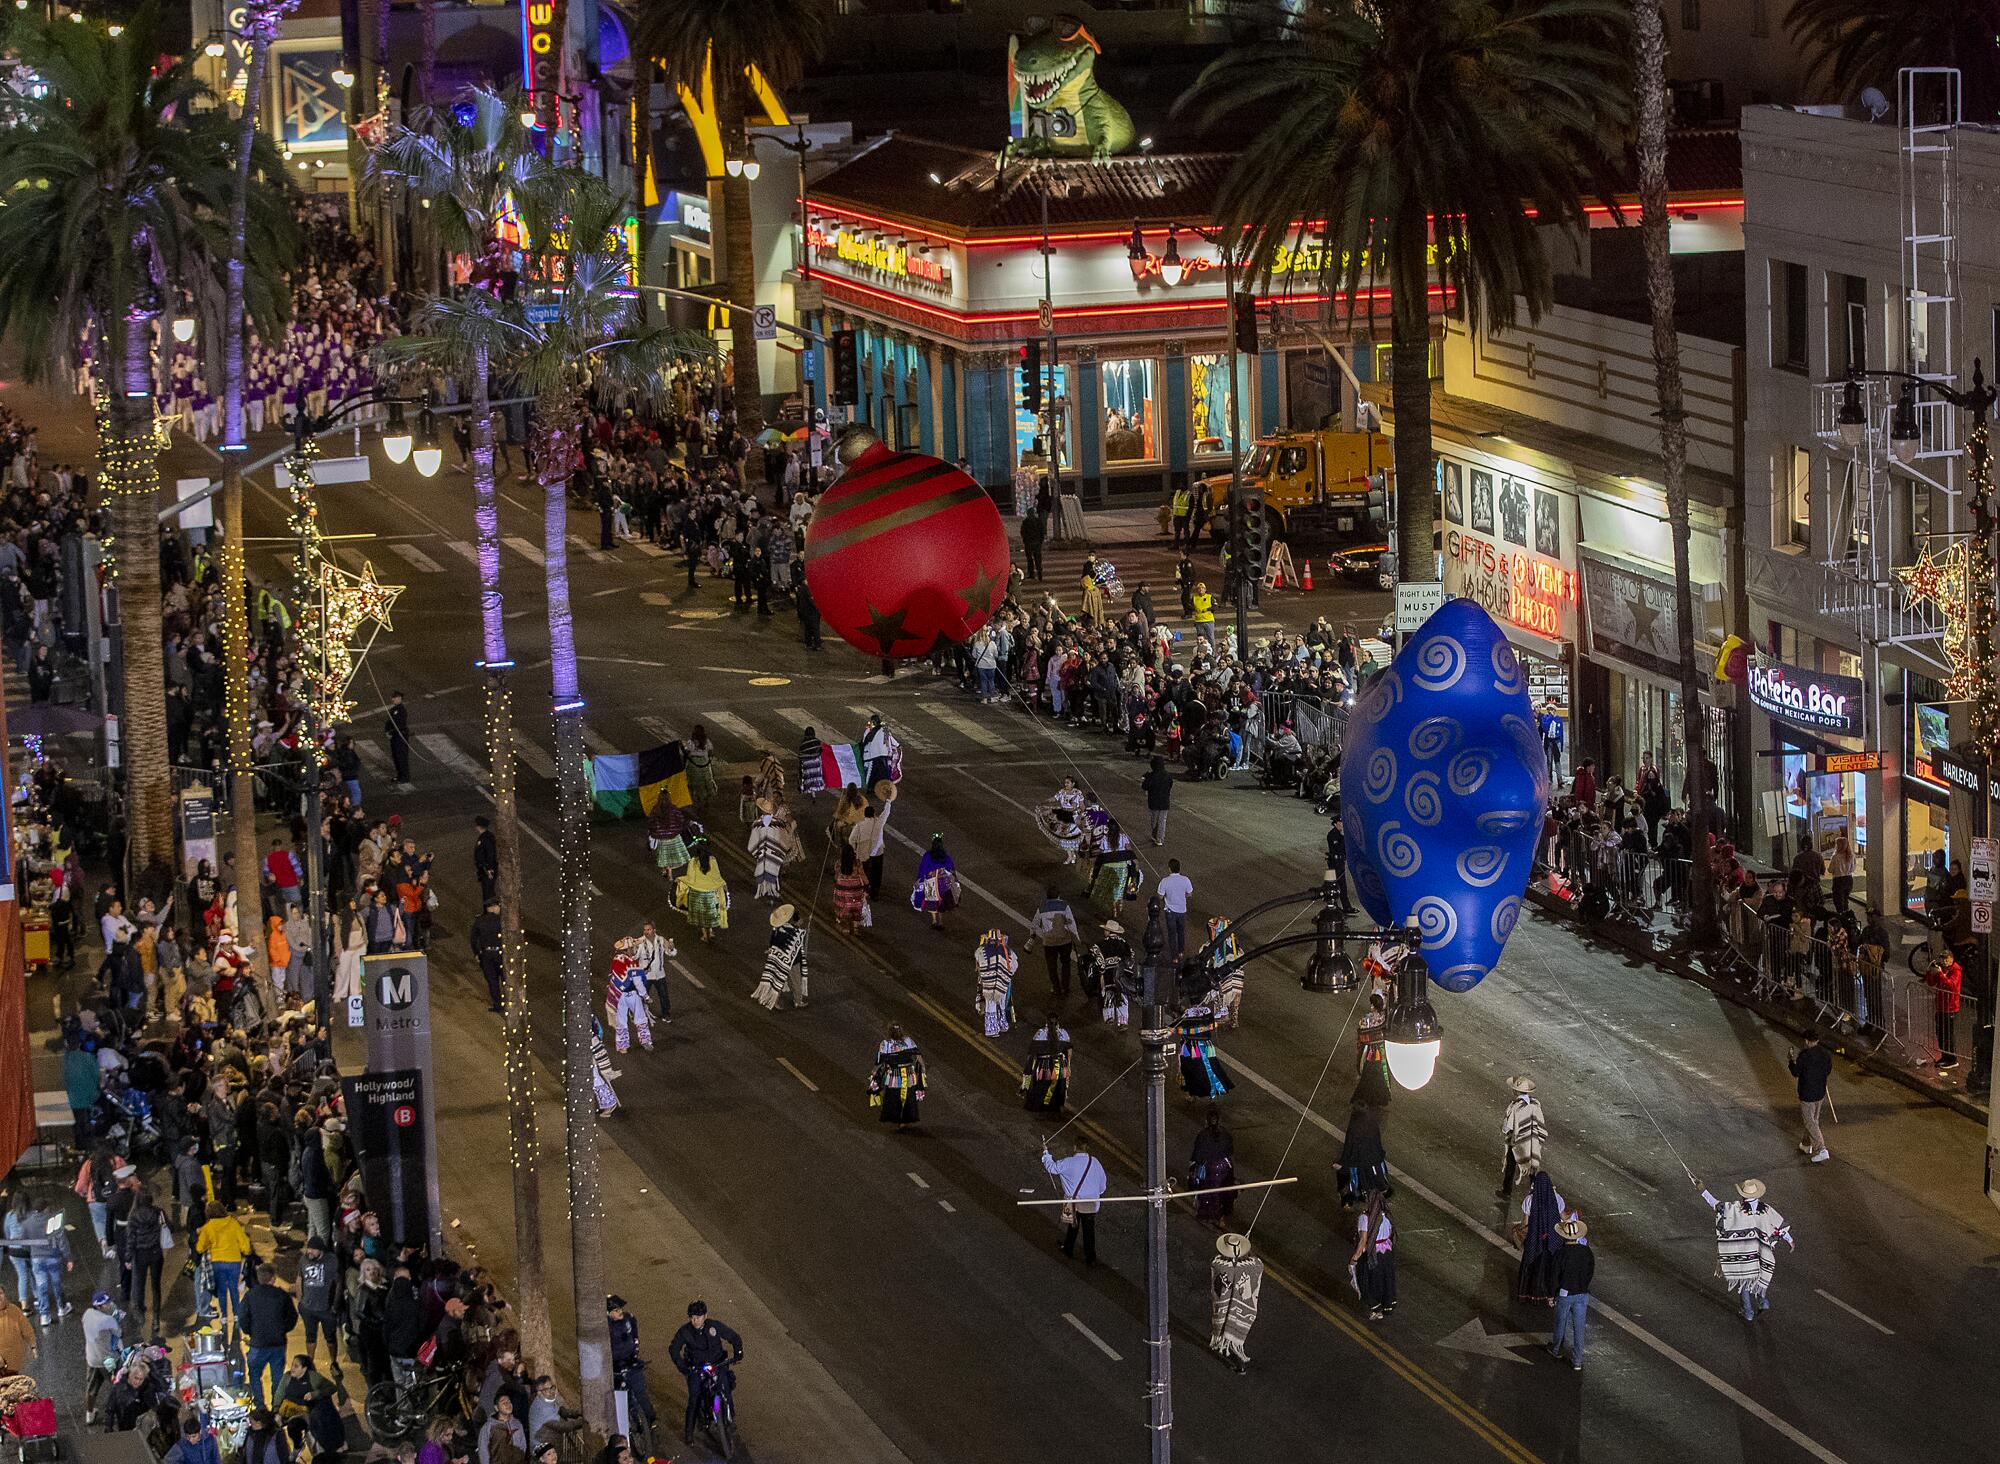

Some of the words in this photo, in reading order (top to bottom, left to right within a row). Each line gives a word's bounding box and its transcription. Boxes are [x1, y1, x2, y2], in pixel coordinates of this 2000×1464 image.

[1448, 530, 1495, 572] GIFTS
[1499, 553, 1508, 575] &
[1511, 552, 1574, 601] SOUVENIRS
[1399, 590, 1420, 598] RIGHT
[1404, 603, 1435, 611] MUST
[1476, 577, 1511, 617] HOUR
[1511, 585, 1556, 634] PHOTO
[1808, 683, 1846, 716] Bar
[1760, 699, 1783, 714] GOURMET
[1785, 708, 1815, 723] MEXICAN
[1818, 716, 1842, 728] POPS
[1830, 753, 1877, 764] VISITOR
[1832, 761, 1875, 772] CENTER
[1975, 881, 1992, 889] ONLY
[375, 1016, 421, 1031] Metro
[354, 1078, 415, 1093] Hollywood/
[368, 1091, 416, 1104] Highland
[400, 1109, 411, 1123] B
